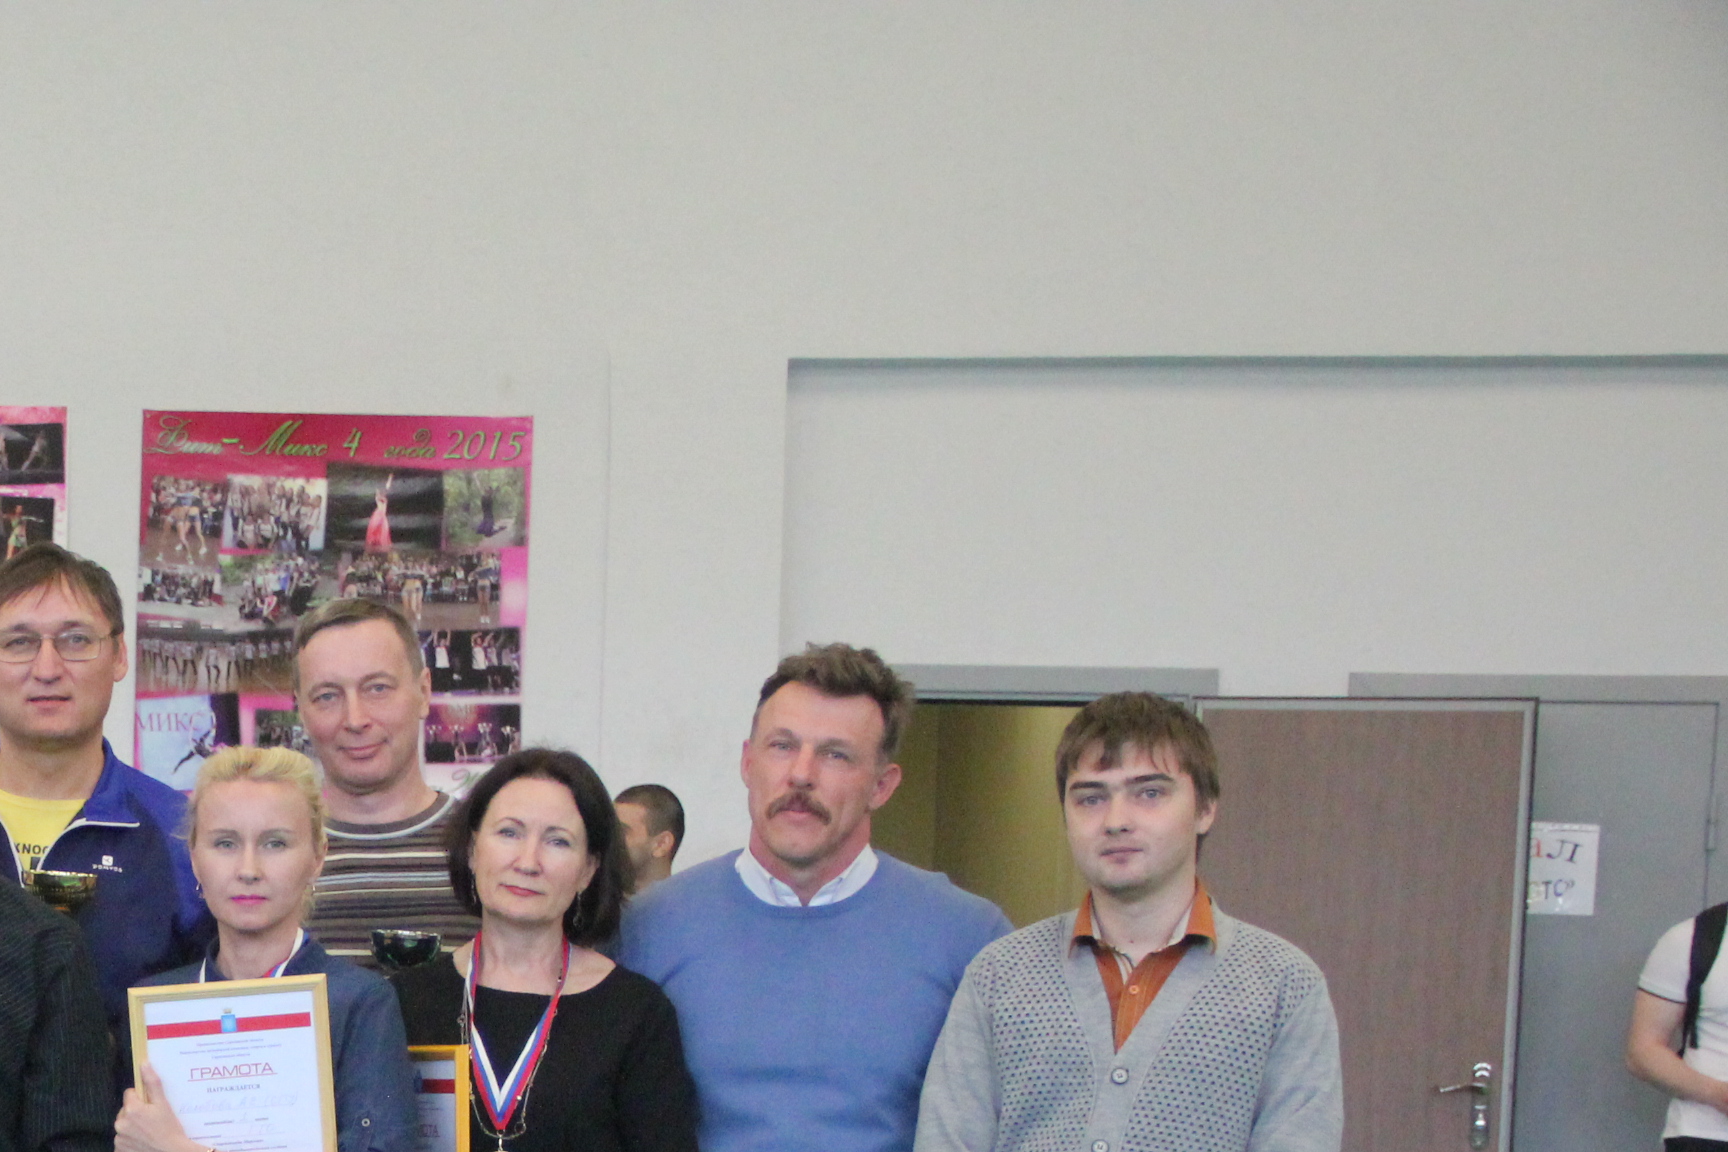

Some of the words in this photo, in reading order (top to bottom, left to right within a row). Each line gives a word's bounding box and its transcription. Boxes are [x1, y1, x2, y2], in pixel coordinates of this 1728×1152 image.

[342, 427, 361, 458] 4
[443, 430, 526, 461] 2015
[190, 1062, 274, 1080] ГРАМОТА
